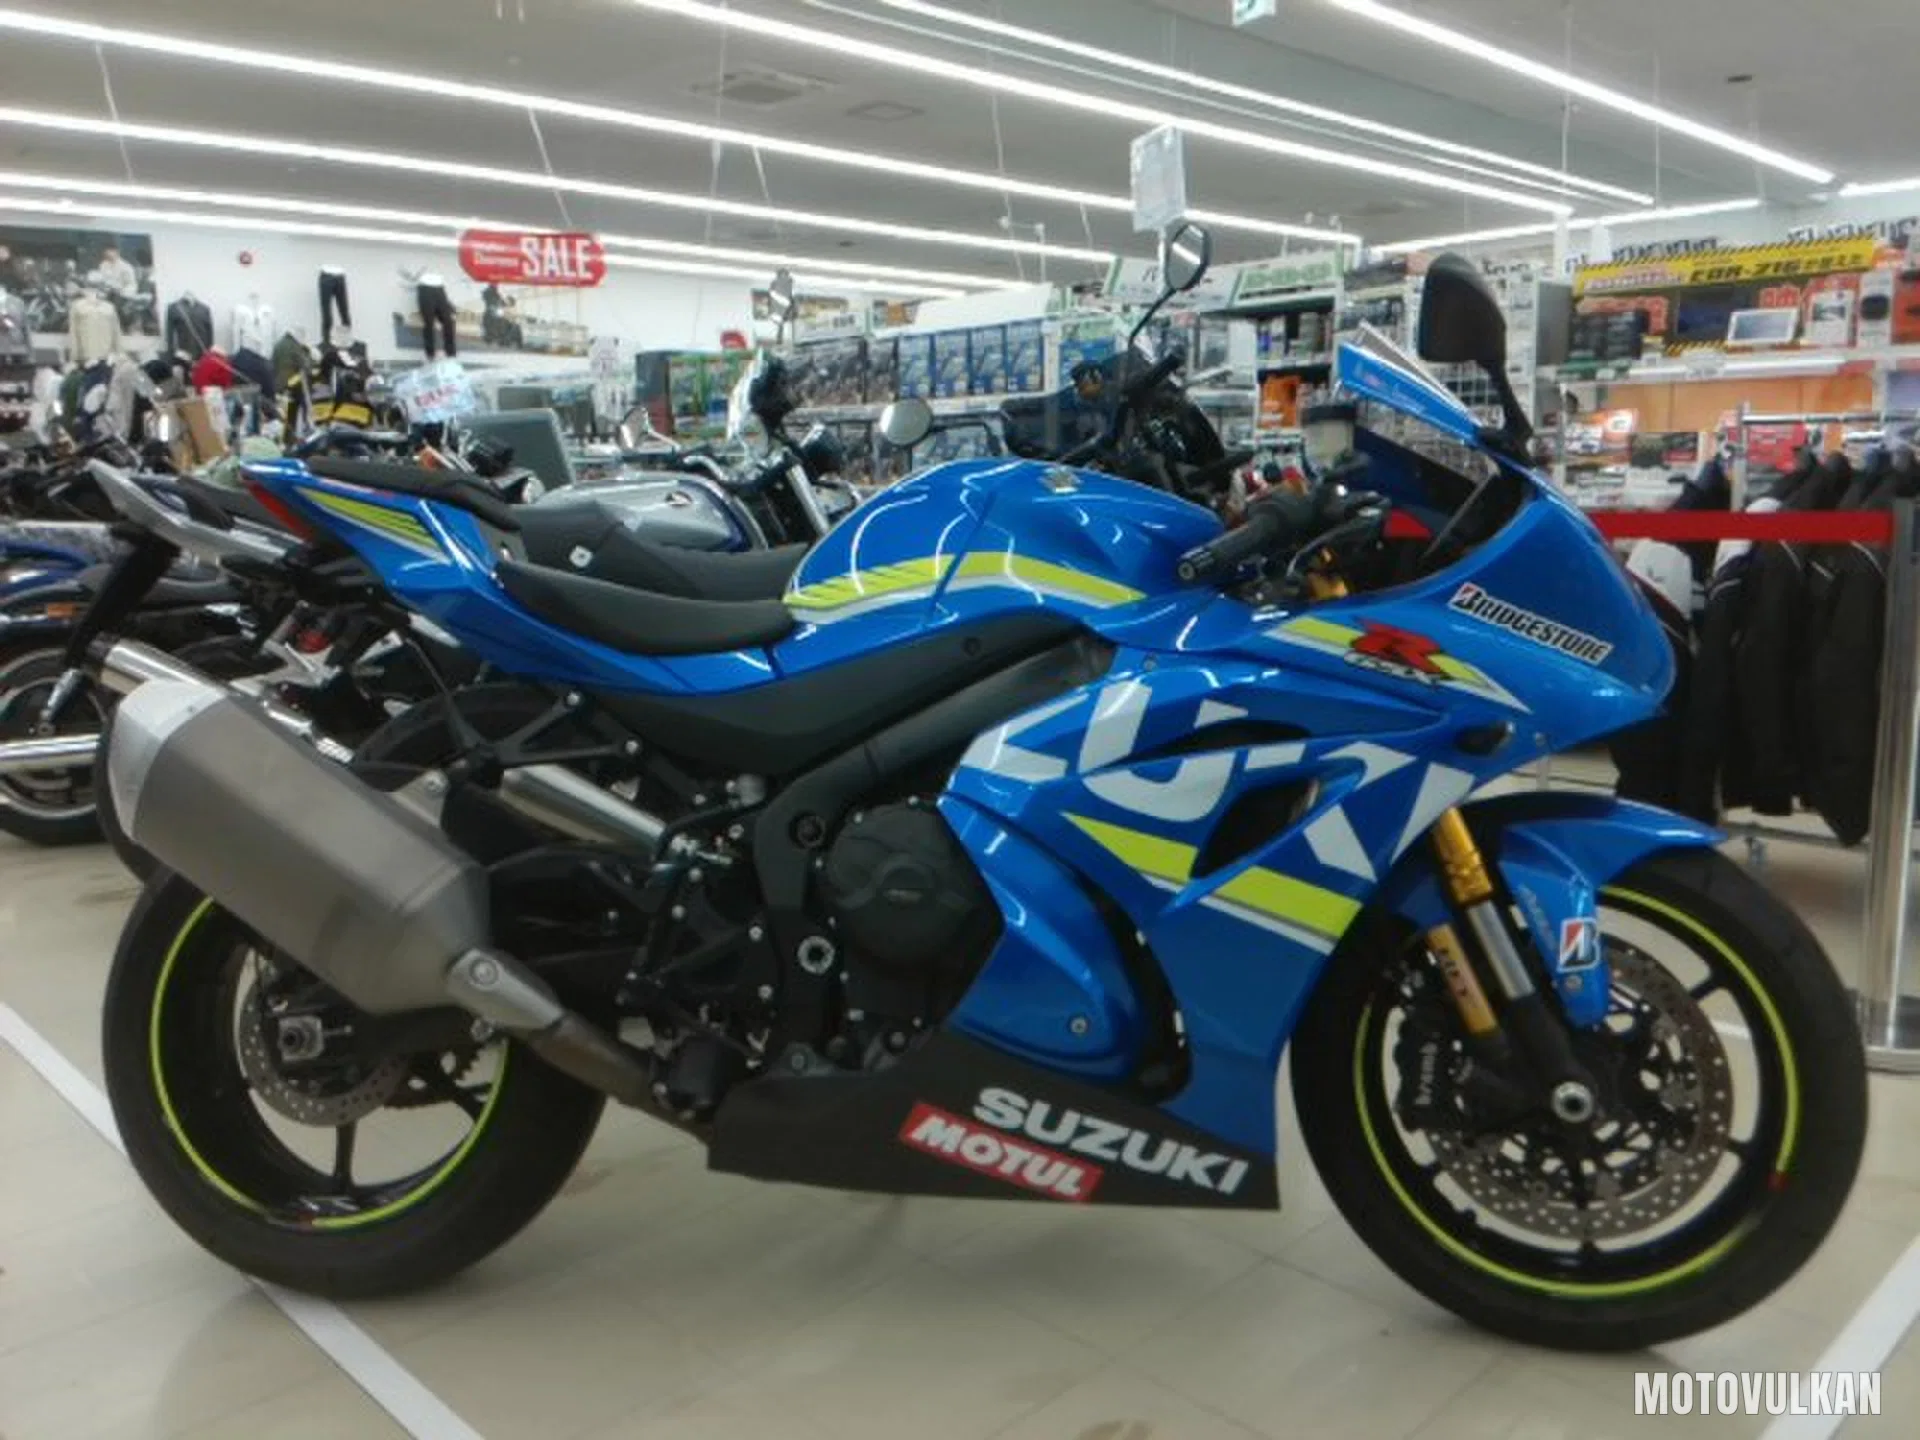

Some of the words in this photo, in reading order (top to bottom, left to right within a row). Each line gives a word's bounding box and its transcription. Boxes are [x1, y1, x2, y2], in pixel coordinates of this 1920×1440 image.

[519, 236, 593, 279] SALE
[1455, 585, 1607, 660] BRIDGESTONE
[911, 1114, 1086, 1196] MOTUL
[973, 1087, 1249, 1195] SUZUKI
